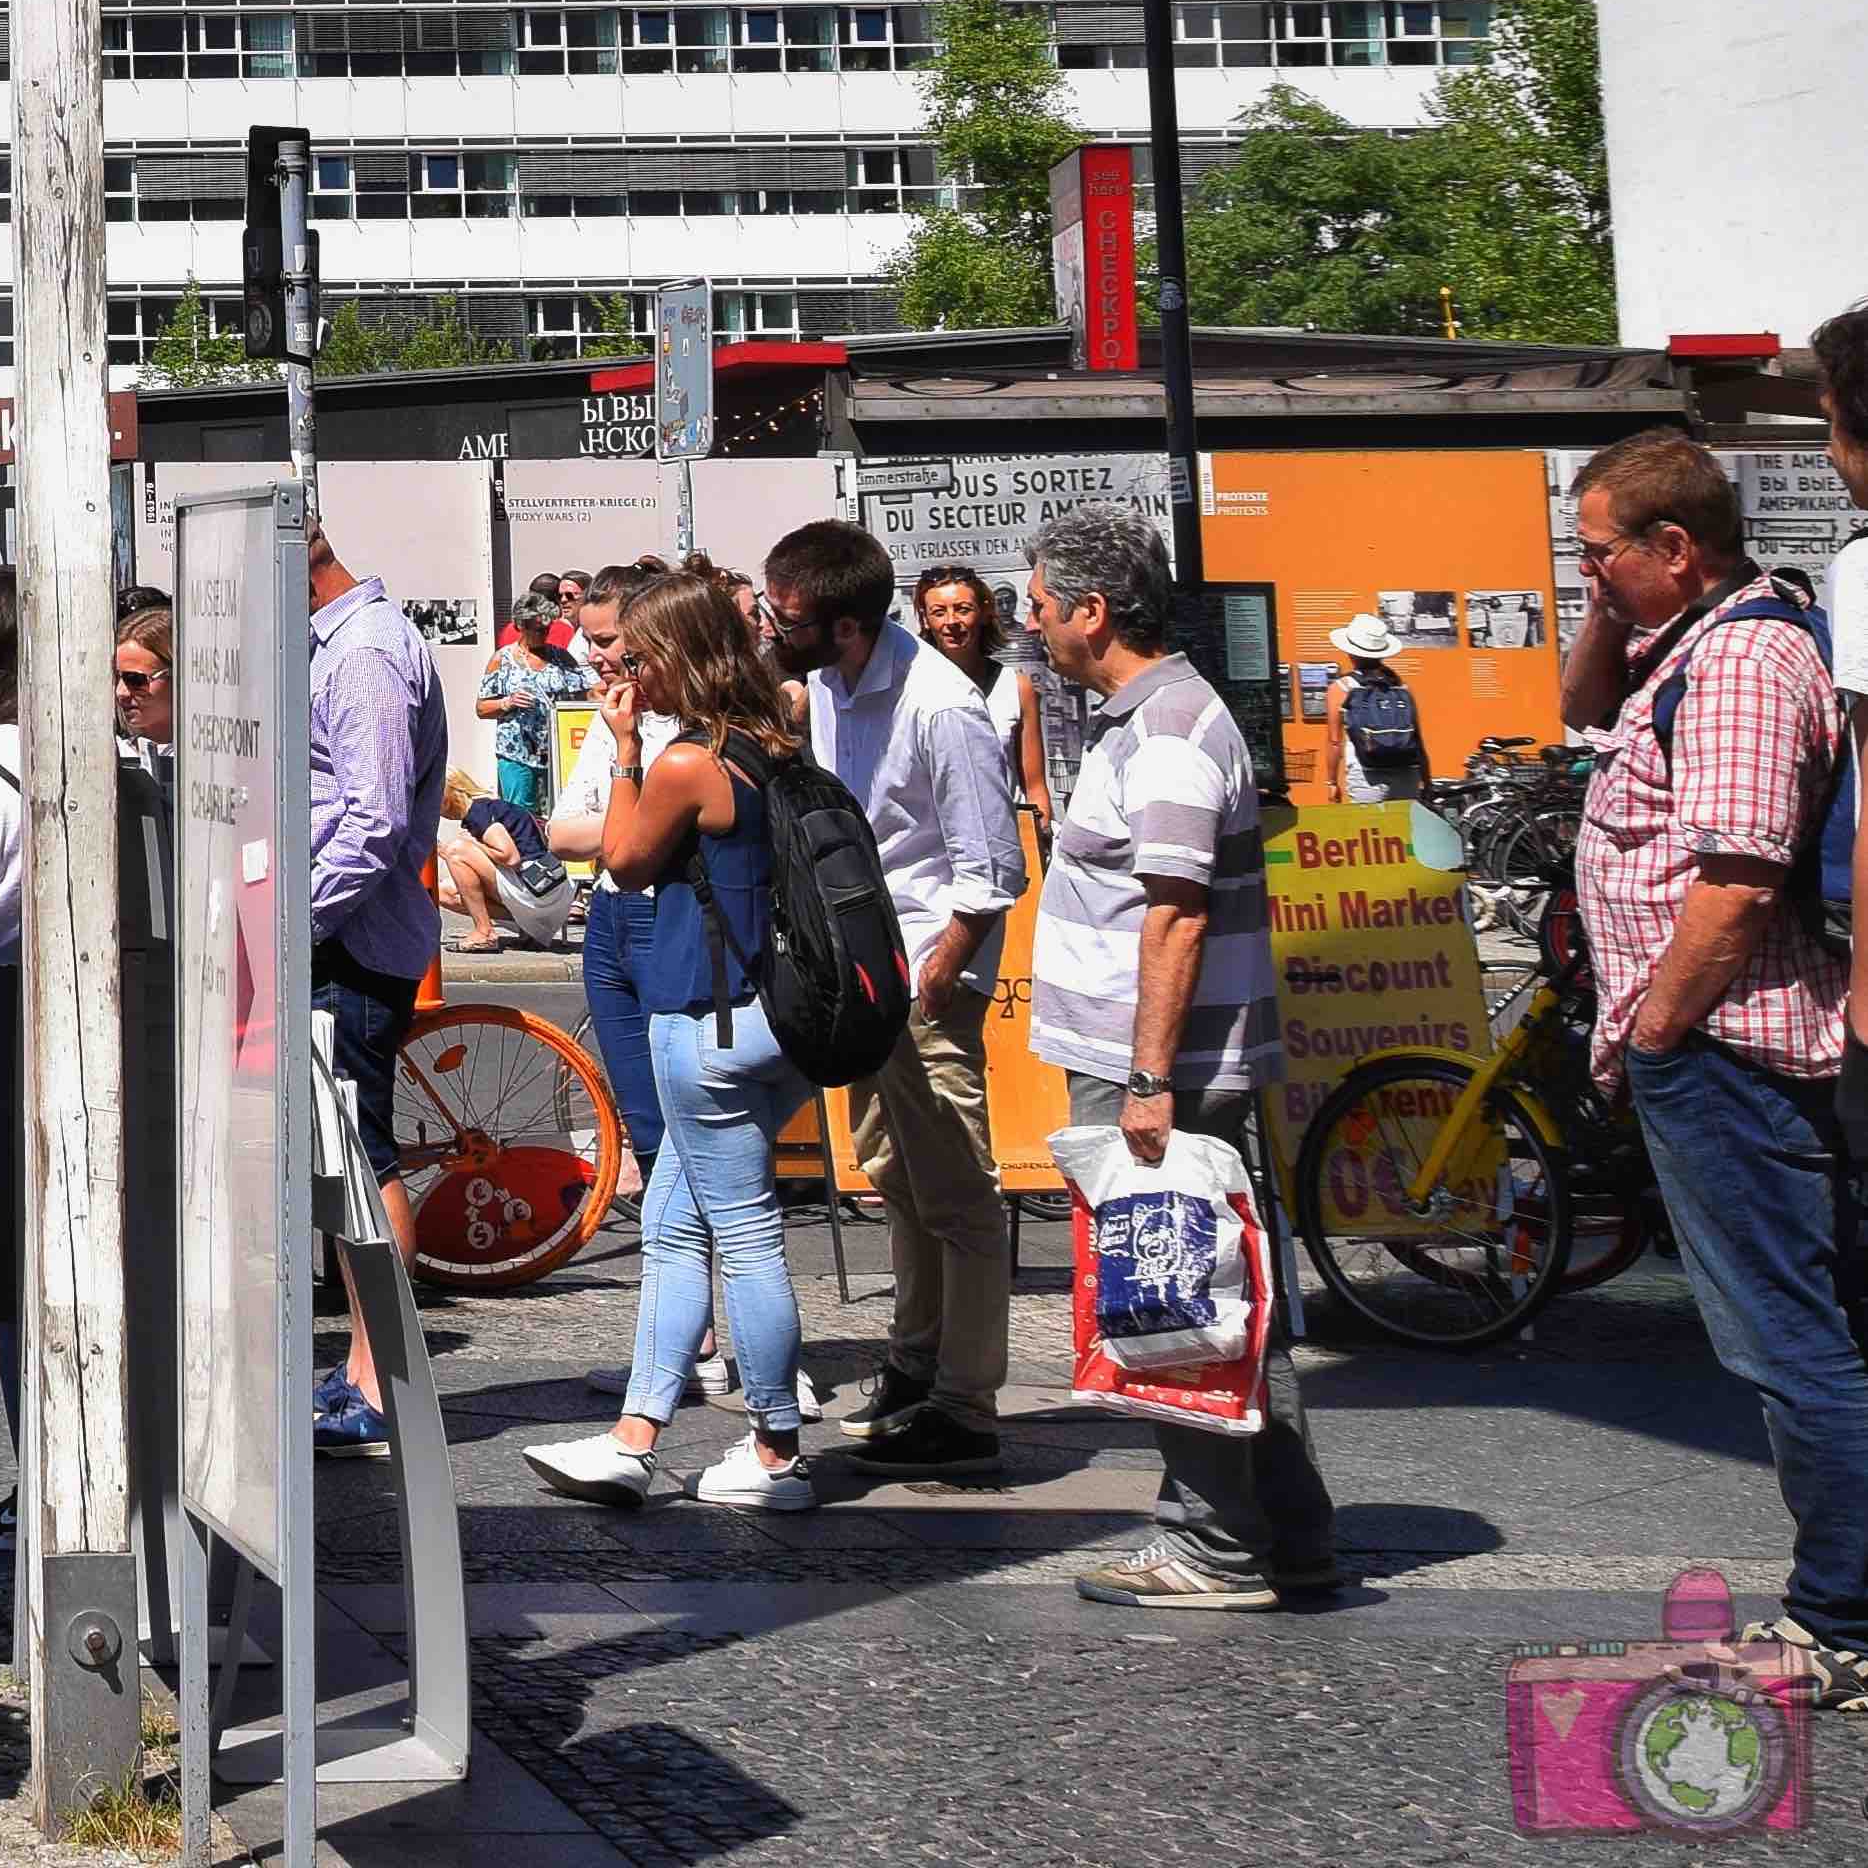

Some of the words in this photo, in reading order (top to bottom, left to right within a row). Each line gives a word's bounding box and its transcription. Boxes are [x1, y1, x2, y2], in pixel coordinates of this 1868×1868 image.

[1099, 211, 1121, 370] CHECKPO
[1013, 467, 1114, 496] SORTEZ
[886, 508, 914, 533] DU
[928, 502, 1027, 531] SECTEUR
[914, 539, 981, 559] VERLASSEN
[985, 538, 1010, 556] DEN
[191, 579, 238, 618] MUSEUM
[191, 647, 220, 685] HAUS
[223, 648, 241, 686] AM
[191, 713, 261, 759] CHECKPOINT
[191, 780, 236, 826] CHARLIE
[1296, 828, 1406, 869] Berlin
[1284, 951, 1453, 996] Discount
[1284, 1013, 1470, 1060] Souvenirs
